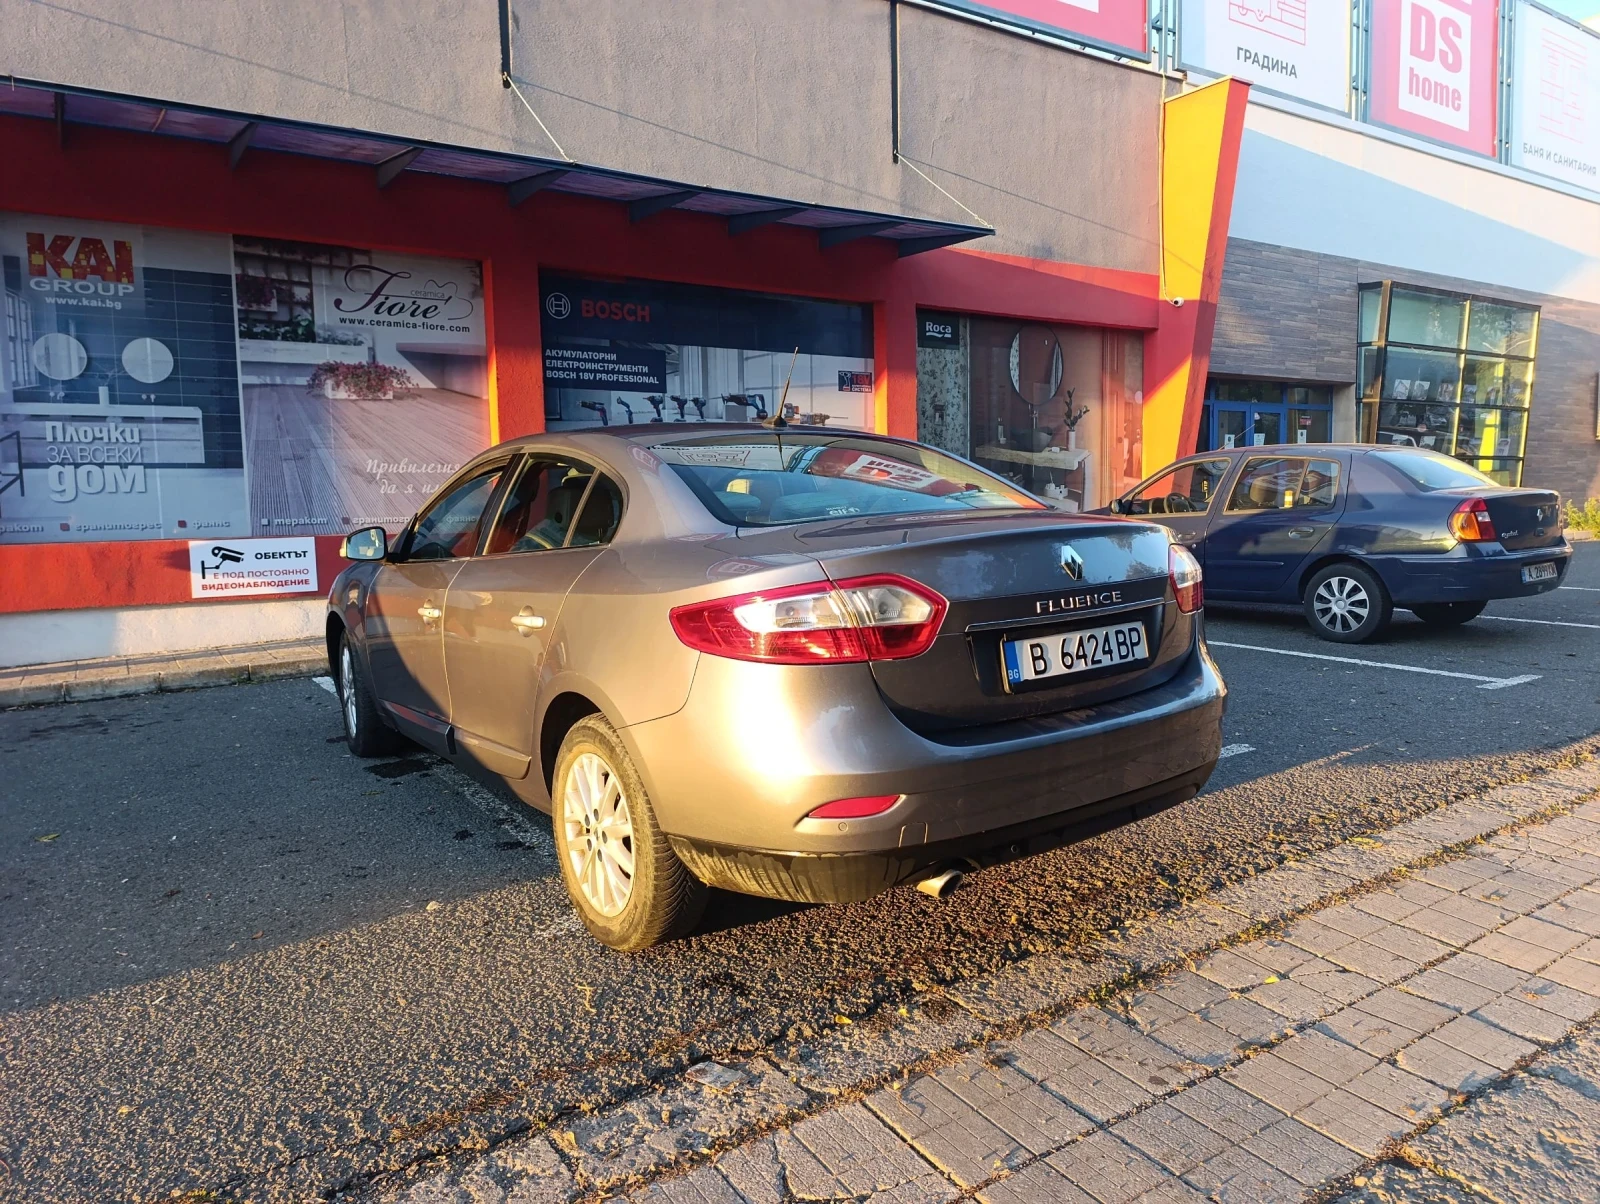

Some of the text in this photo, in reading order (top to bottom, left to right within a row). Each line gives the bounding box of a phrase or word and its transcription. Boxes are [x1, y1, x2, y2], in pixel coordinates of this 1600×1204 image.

[1410, 2, 1462, 74] DS
[1236, 47, 1298, 78] ГРАДИНА
[1409, 68, 1462, 112] home
[1523, 142, 1597, 177] БАНЯ И САНИТАРИЯ
[26, 232, 135, 284] KAI
[29, 278, 135, 297] GROUP
[334, 264, 452, 319] Fiore
[411, 288, 445, 299] ceramica
[45, 296, 122, 310] www.kai.bg
[581, 299, 650, 322] BOSCH
[339, 317, 472, 333] www.ceramica-fiore.com
[925, 321, 952, 334] Roca
[545, 349, 617, 361] АКУМУЛАТОРНИ
[545, 360, 649, 373] ЕЛЕКТРОИНСТРУМЕНТИ
[546, 370, 660, 384] BOSCH 18V PROFESSIONAL
[45, 421, 142, 443] Плочки
[47, 446, 143, 464] ЗА ВСЕКИ
[49, 464, 147, 503] дом
[380, 479, 398, 494] да
[404, 483, 415, 494] я
[255, 550, 308, 560] ОБЕКТЪТ
[222, 571, 245, 579] ПОД
[248, 568, 310, 578] ПОСТОЯННО
[201, 578, 310, 591] ВИДЕОНАБЛЮДЕНИЕ
[1036, 590, 1123, 613] FLUENCE
[1029, 642, 1048, 676] B
[1008, 668, 1020, 680] BG
